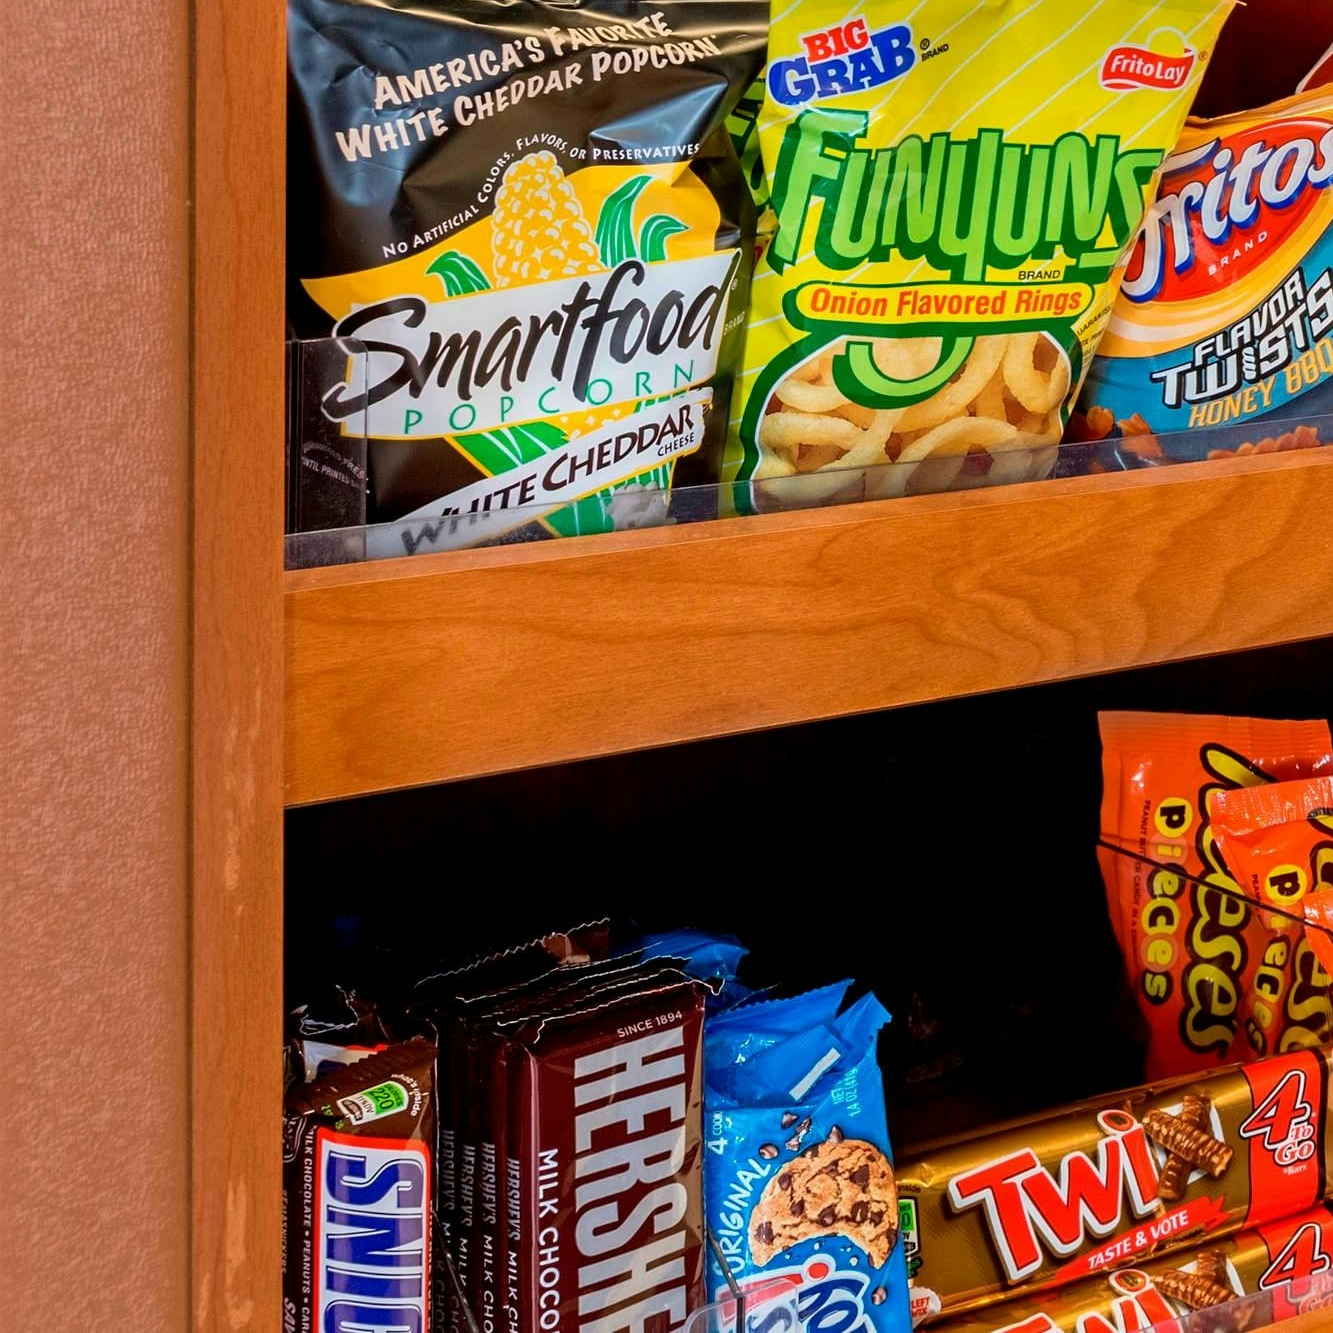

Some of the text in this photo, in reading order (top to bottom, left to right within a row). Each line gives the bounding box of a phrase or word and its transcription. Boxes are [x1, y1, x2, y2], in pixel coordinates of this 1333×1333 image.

[373, 11, 674, 111] AMERICA'S FAVORITE
[768, 25, 916, 106] GRAB
[802, 18, 870, 64] BIG
[920, 42, 950, 63] BRAND
[334, 36, 722, 163] WHITE CHEDDAR POPCORN
[382, 239, 408, 259] NO
[412, 204, 481, 250] ARTIFICIAL
[569, 147, 587, 161] OR
[592, 141, 701, 162] PRESERVATIVES
[1017, 268, 1062, 281] BRAND
[1206, 230, 1269, 278] BRAND
[810, 287, 1084, 317] Onion Flavored Rings
[1193, 270, 1306, 368] FLAVOR
[320, 258, 736, 423] Smartfood
[403, 358, 695, 434] POPCORN
[1188, 373, 1277, 429] HONEY
[400, 403, 695, 556] WHITE CHEDDAR
[656, 431, 696, 458] CHEESE
[1140, 800, 1191, 1004] pieces
[616, 1009, 684, 1039] SINCE 1894
[368, 1086, 396, 1111] 220
[1240, 1069, 1312, 1150] 4
[574, 1026, 690, 1333] HERSHE
[706, 1137, 729, 1155] 4
[537, 1147, 559, 1219] MILK
[714, 1157, 773, 1276] ORIGINAL
[301, 1156, 315, 1294] CHOCOLATE PEANUTS
[1086, 1210, 1191, 1271] TASTE & VOTE
[507, 1250, 518, 1301] MILK
[911, 1297, 931, 1311] LEFT
